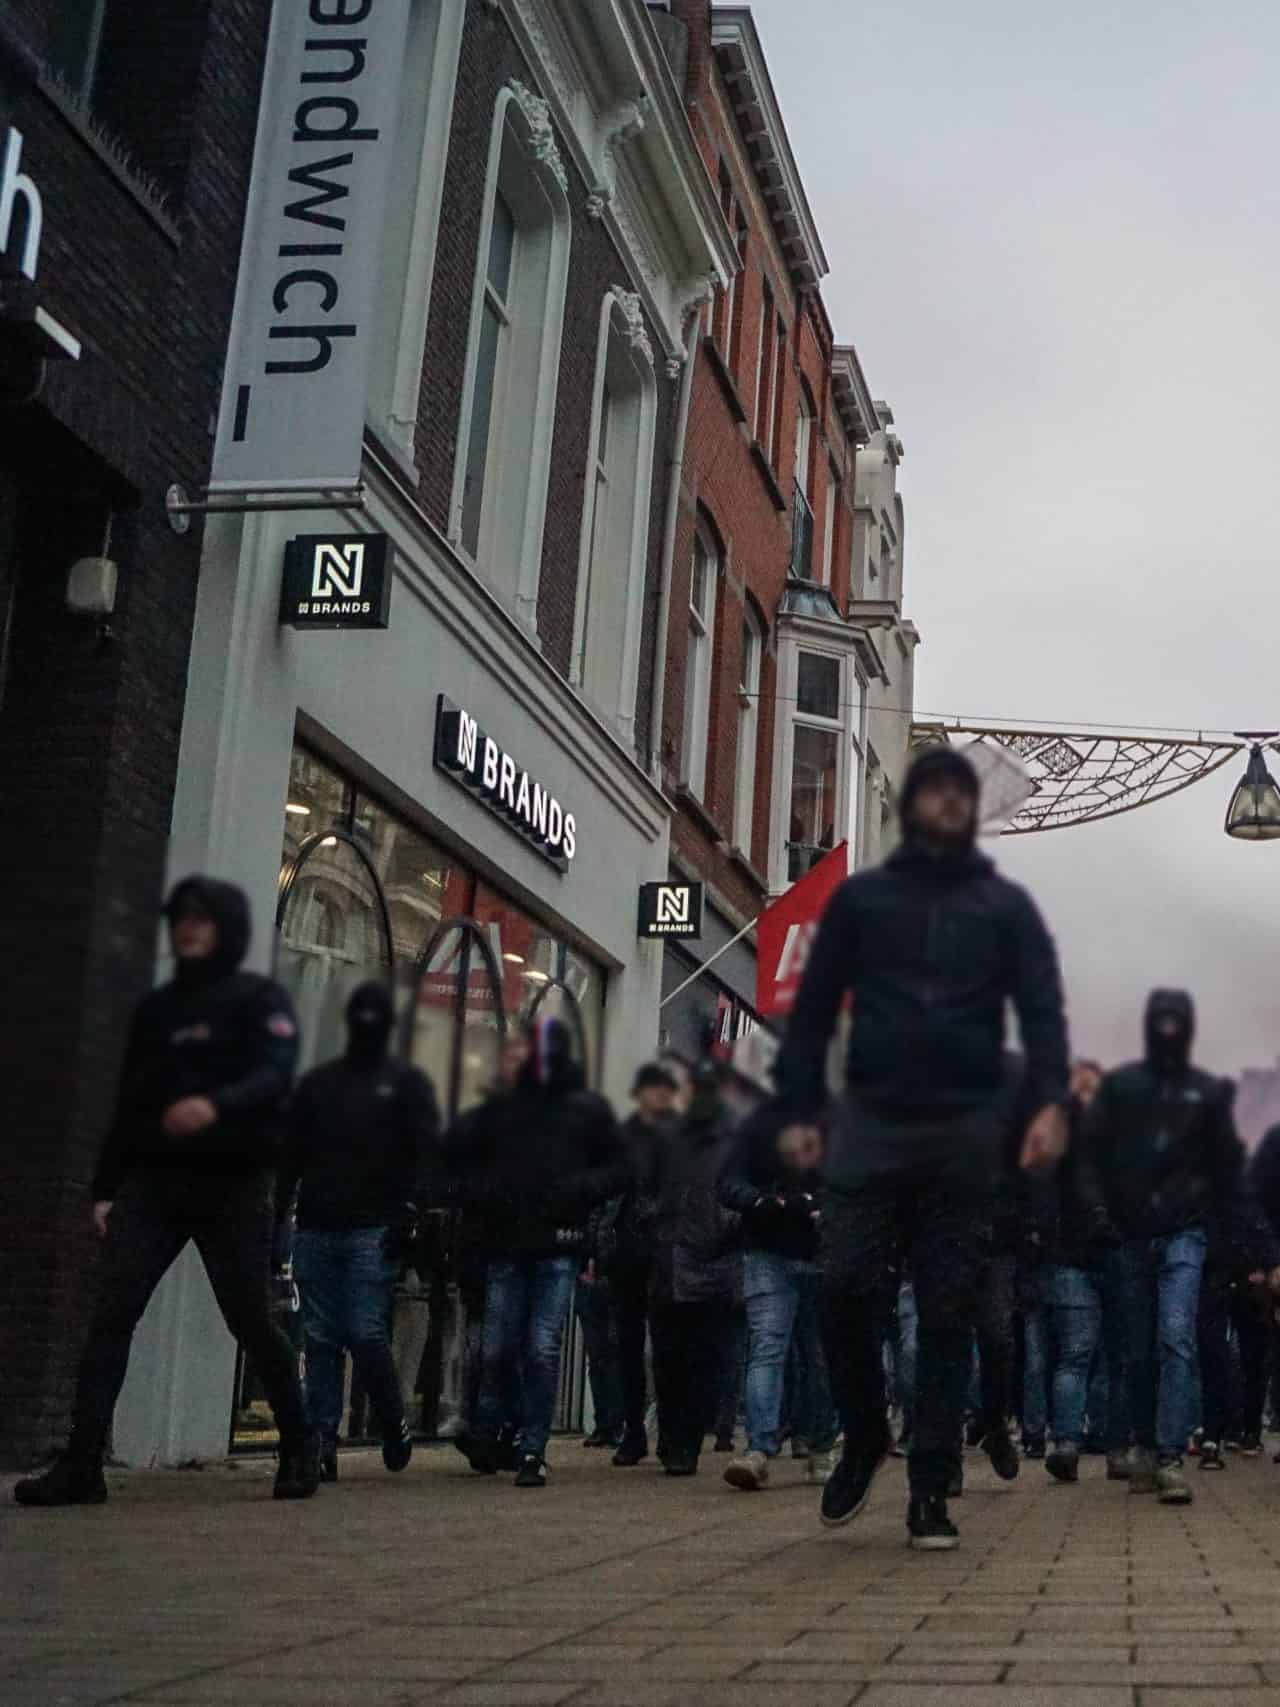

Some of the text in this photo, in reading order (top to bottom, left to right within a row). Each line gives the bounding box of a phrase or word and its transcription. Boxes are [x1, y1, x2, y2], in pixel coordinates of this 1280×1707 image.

[311, 543, 365, 597] N
[312, 602, 371, 614] BRANDS
[457, 709, 576, 859] N BRANDS
[656, 887, 690, 922] N
